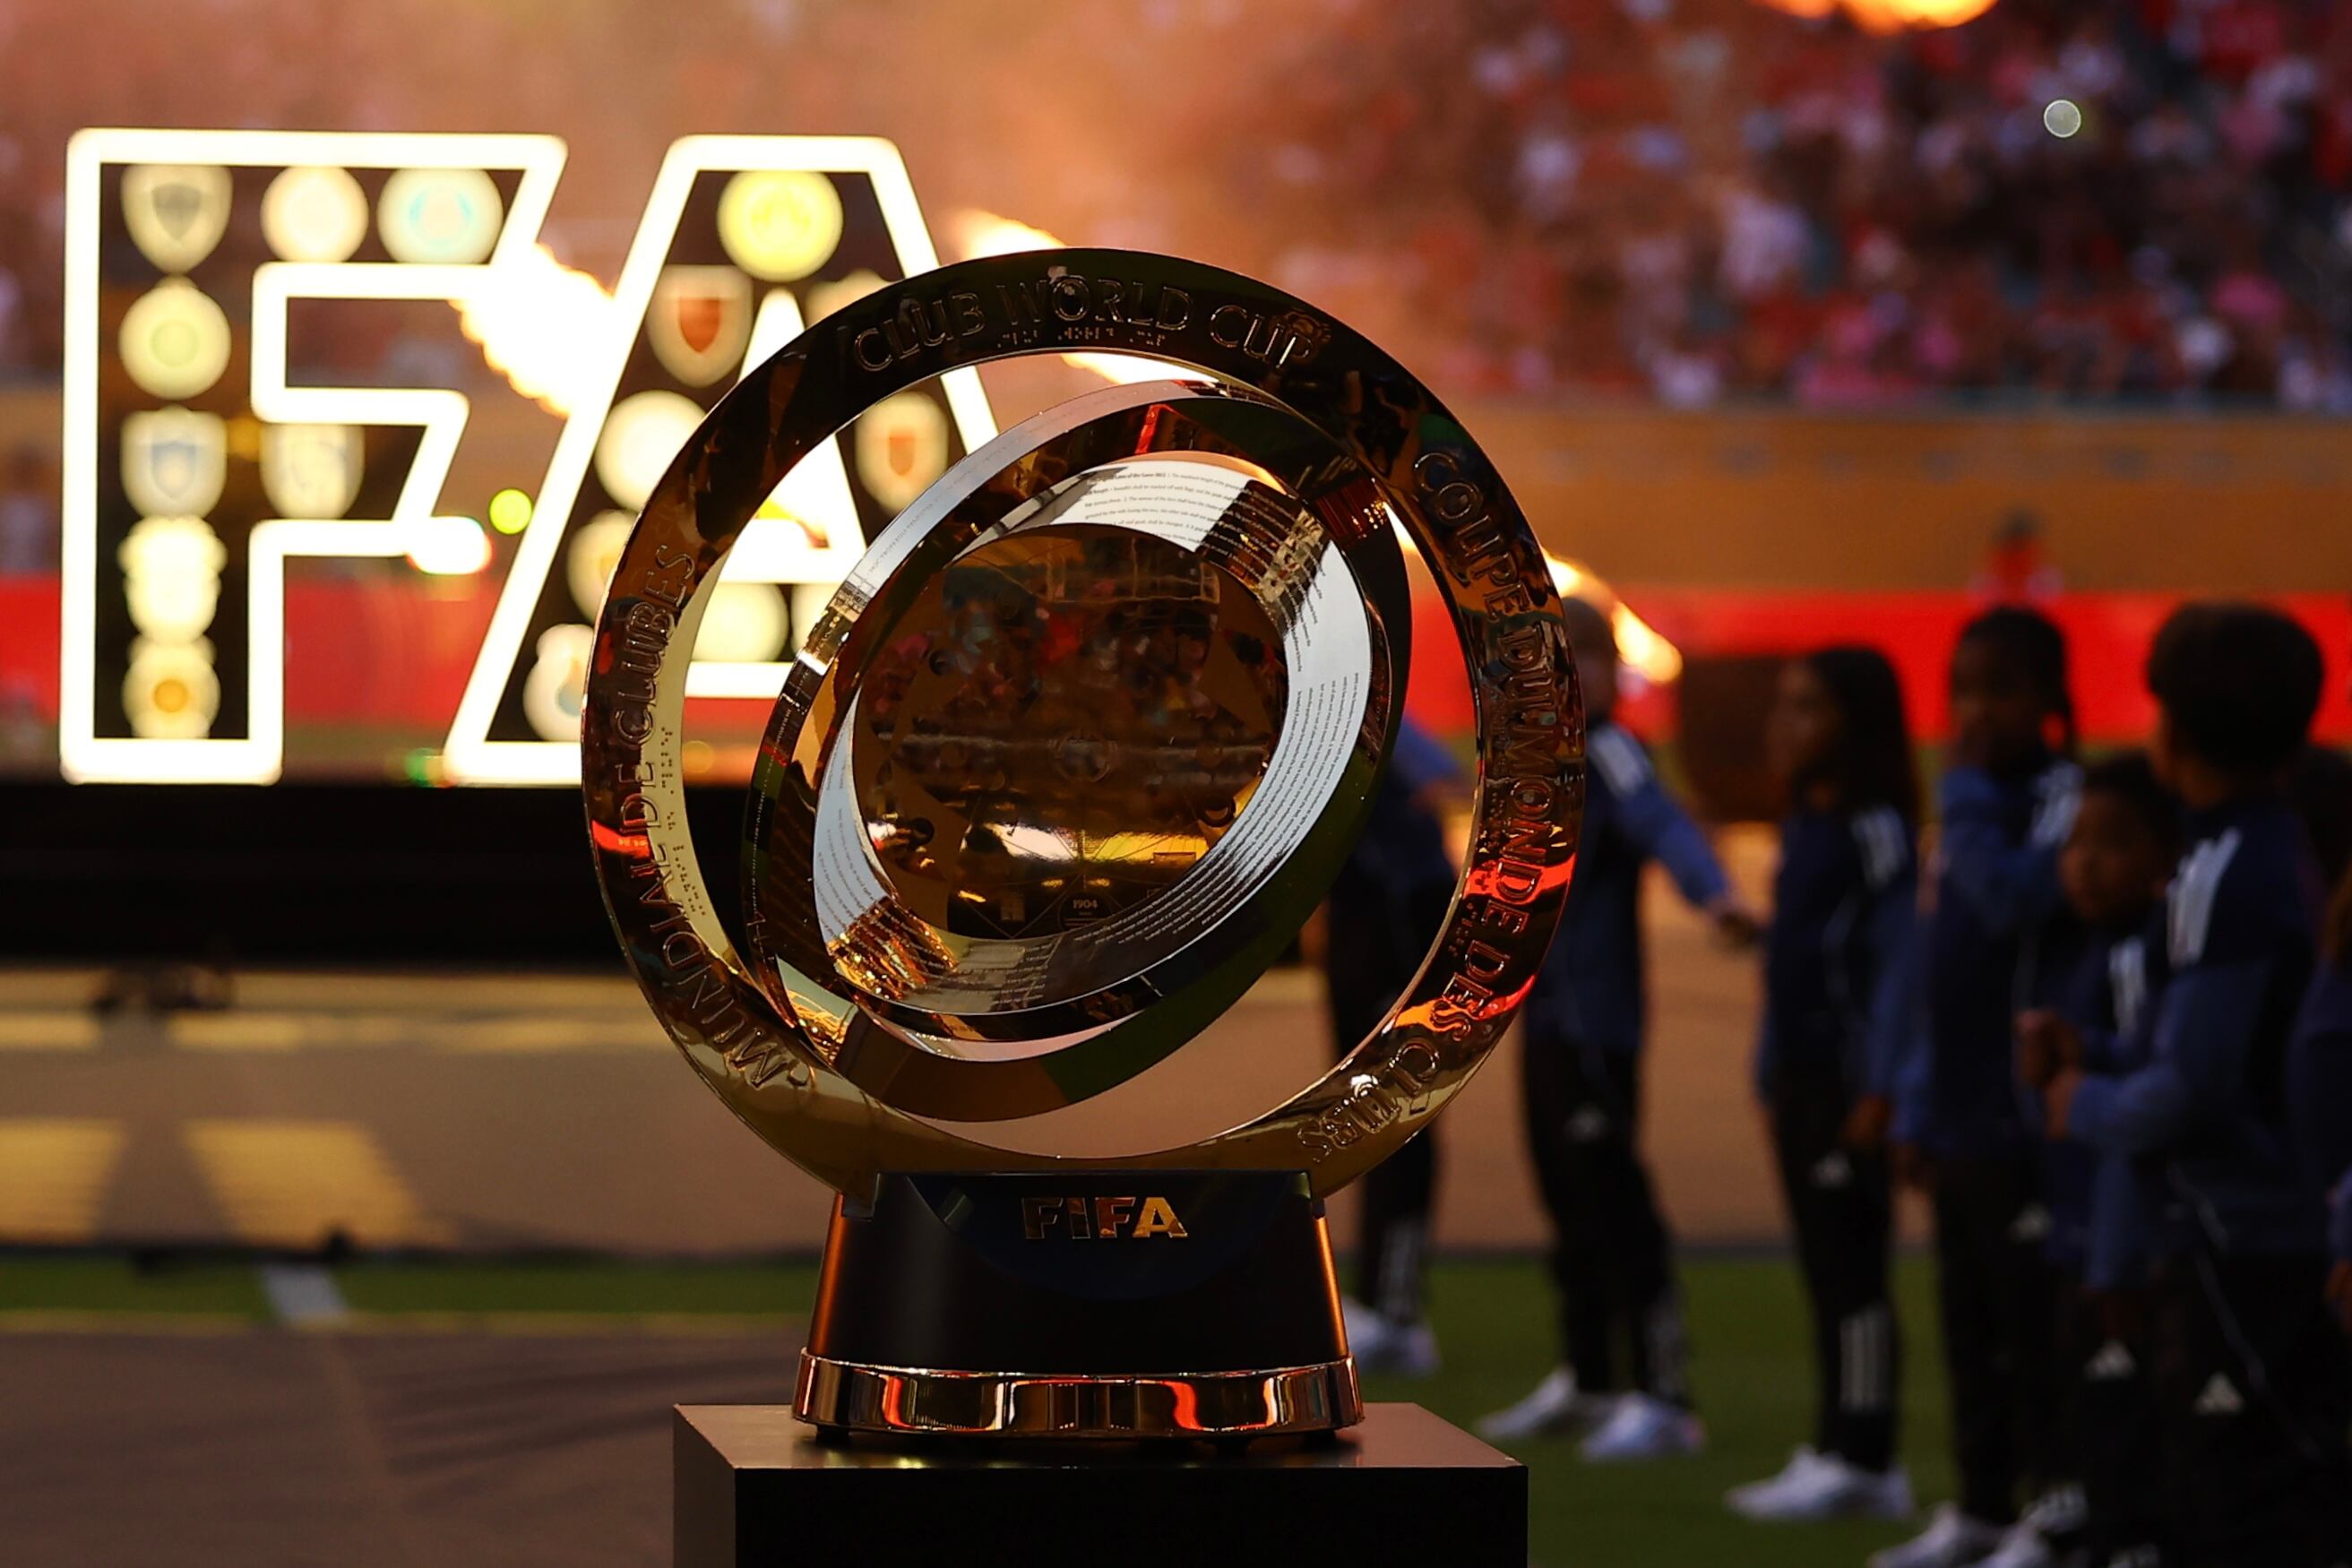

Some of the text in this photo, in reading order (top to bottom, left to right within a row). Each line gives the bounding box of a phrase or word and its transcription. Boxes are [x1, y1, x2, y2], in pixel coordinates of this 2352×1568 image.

[853, 275, 1314, 372] CLUB WORLD CUP
[614, 544, 696, 745] CLUBES
[616, 762, 663, 835] DE
[1297, 452, 1556, 1163] COUPE DU MONDE DES CLUBS
[1073, 900, 1098, 909] 1904
[630, 843, 789, 1090] MUNDIAL
[1021, 1196, 1189, 1240] FIFA
